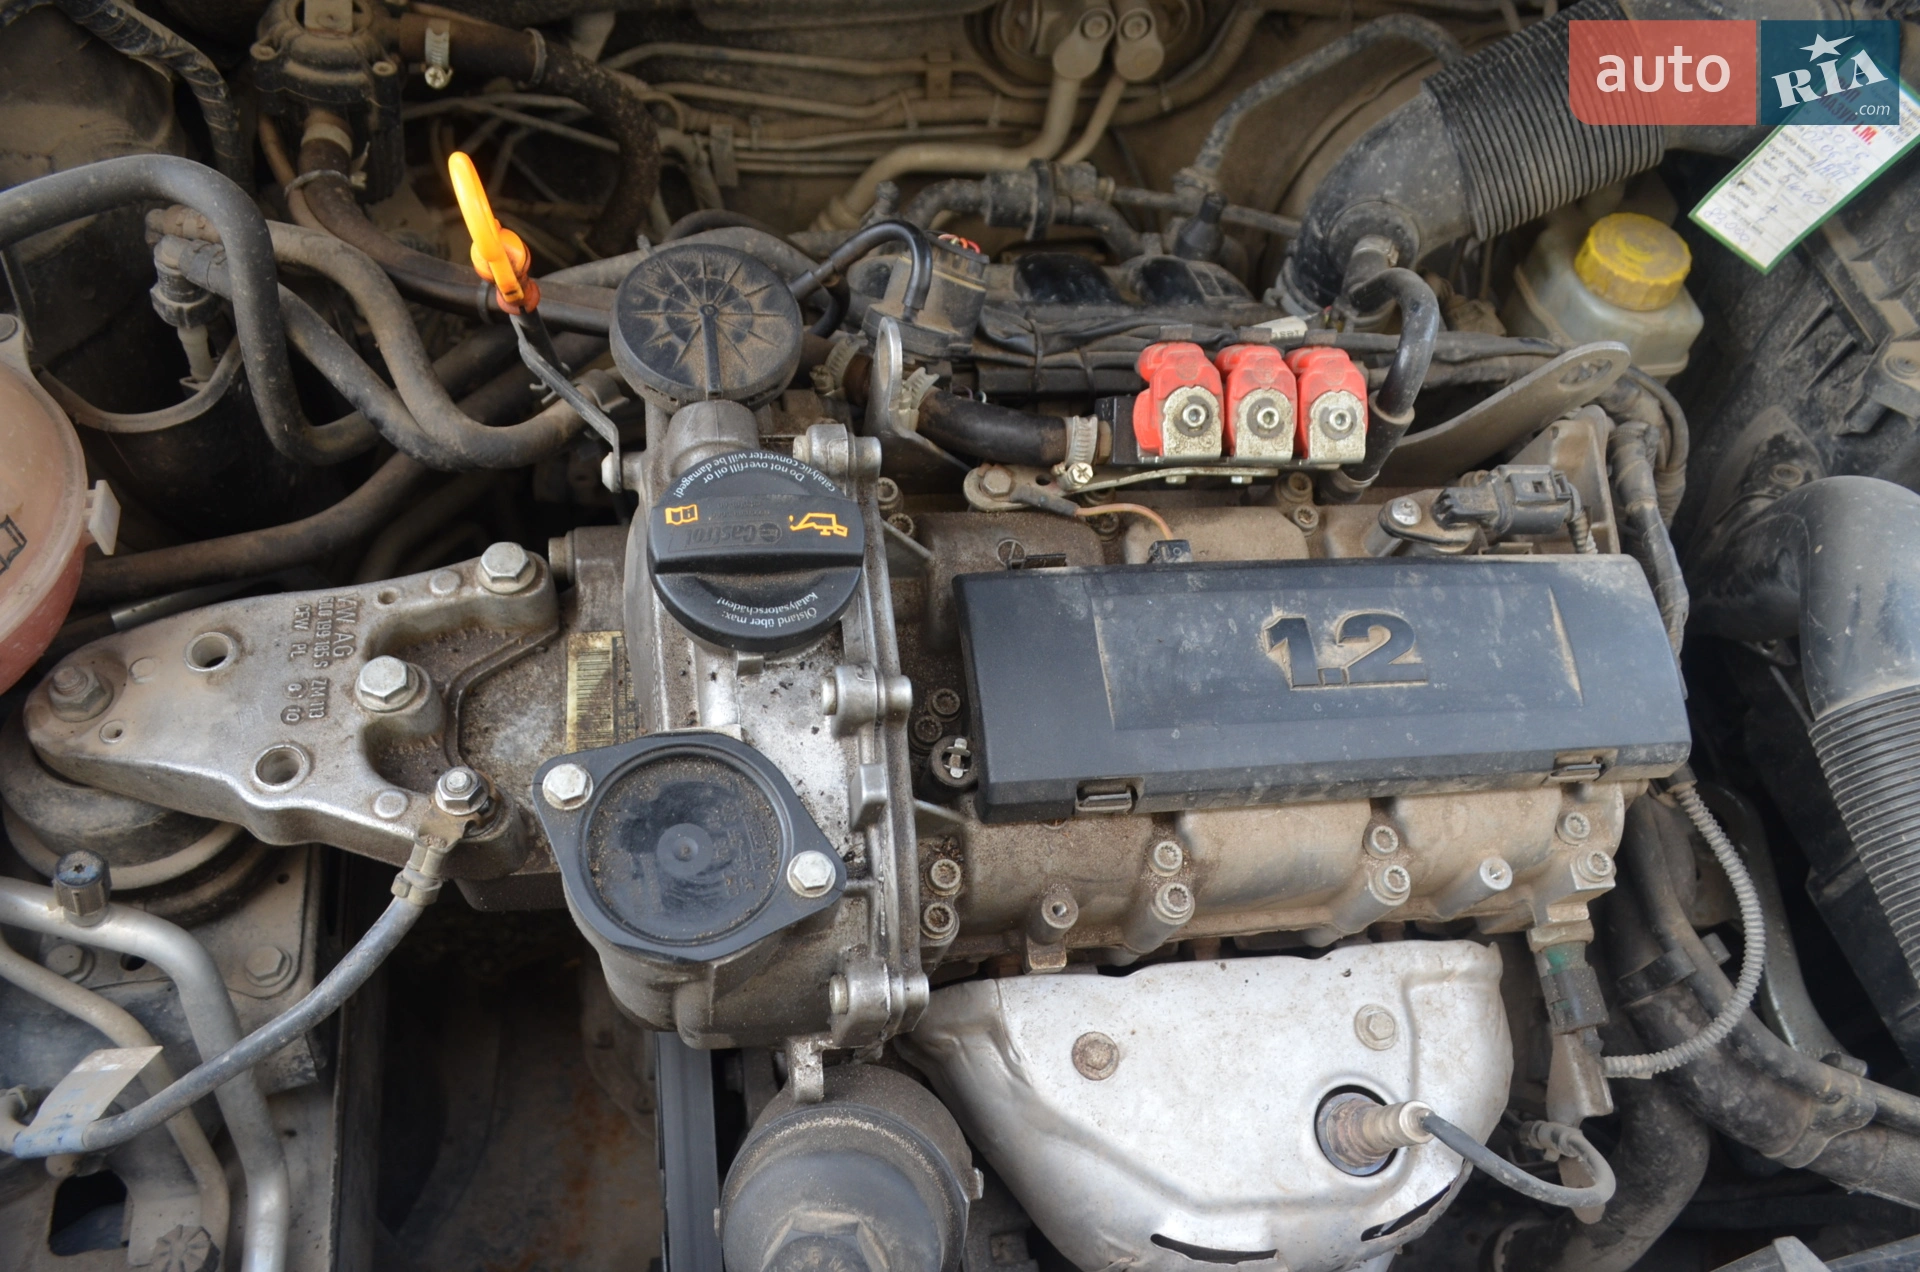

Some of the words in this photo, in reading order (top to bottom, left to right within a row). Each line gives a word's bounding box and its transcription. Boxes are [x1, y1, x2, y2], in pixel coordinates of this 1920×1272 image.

[713, 457, 728, 465] be
[728, 453, 747, 465] will
[749, 452, 798, 467] converter
[714, 467, 728, 478] oil
[730, 462, 768, 473] overfill
[771, 463, 788, 473] not
[673, 463, 712, 498] damaged!
[703, 474, 713, 483] or
[790, 470, 804, 482] Do
[799, 463, 835, 492] catalytic
[686, 525, 756, 545] Castrol
[336, 594, 357, 623] VW
[716, 592, 818, 615] Katalysatorschäden!
[722, 611, 747, 624] max:
[750, 618, 774, 628] über
[777, 607, 817, 627] Ölstand
[316, 620, 332, 637] 199
[290, 643, 307, 658] PL
[314, 641, 330, 658] 185
[333, 632, 354, 657] AG
[1264, 611, 1428, 690] 1.2
[314, 660, 328, 668] S
[310, 680, 327, 697] ZM
[309, 701, 325, 718] 113
